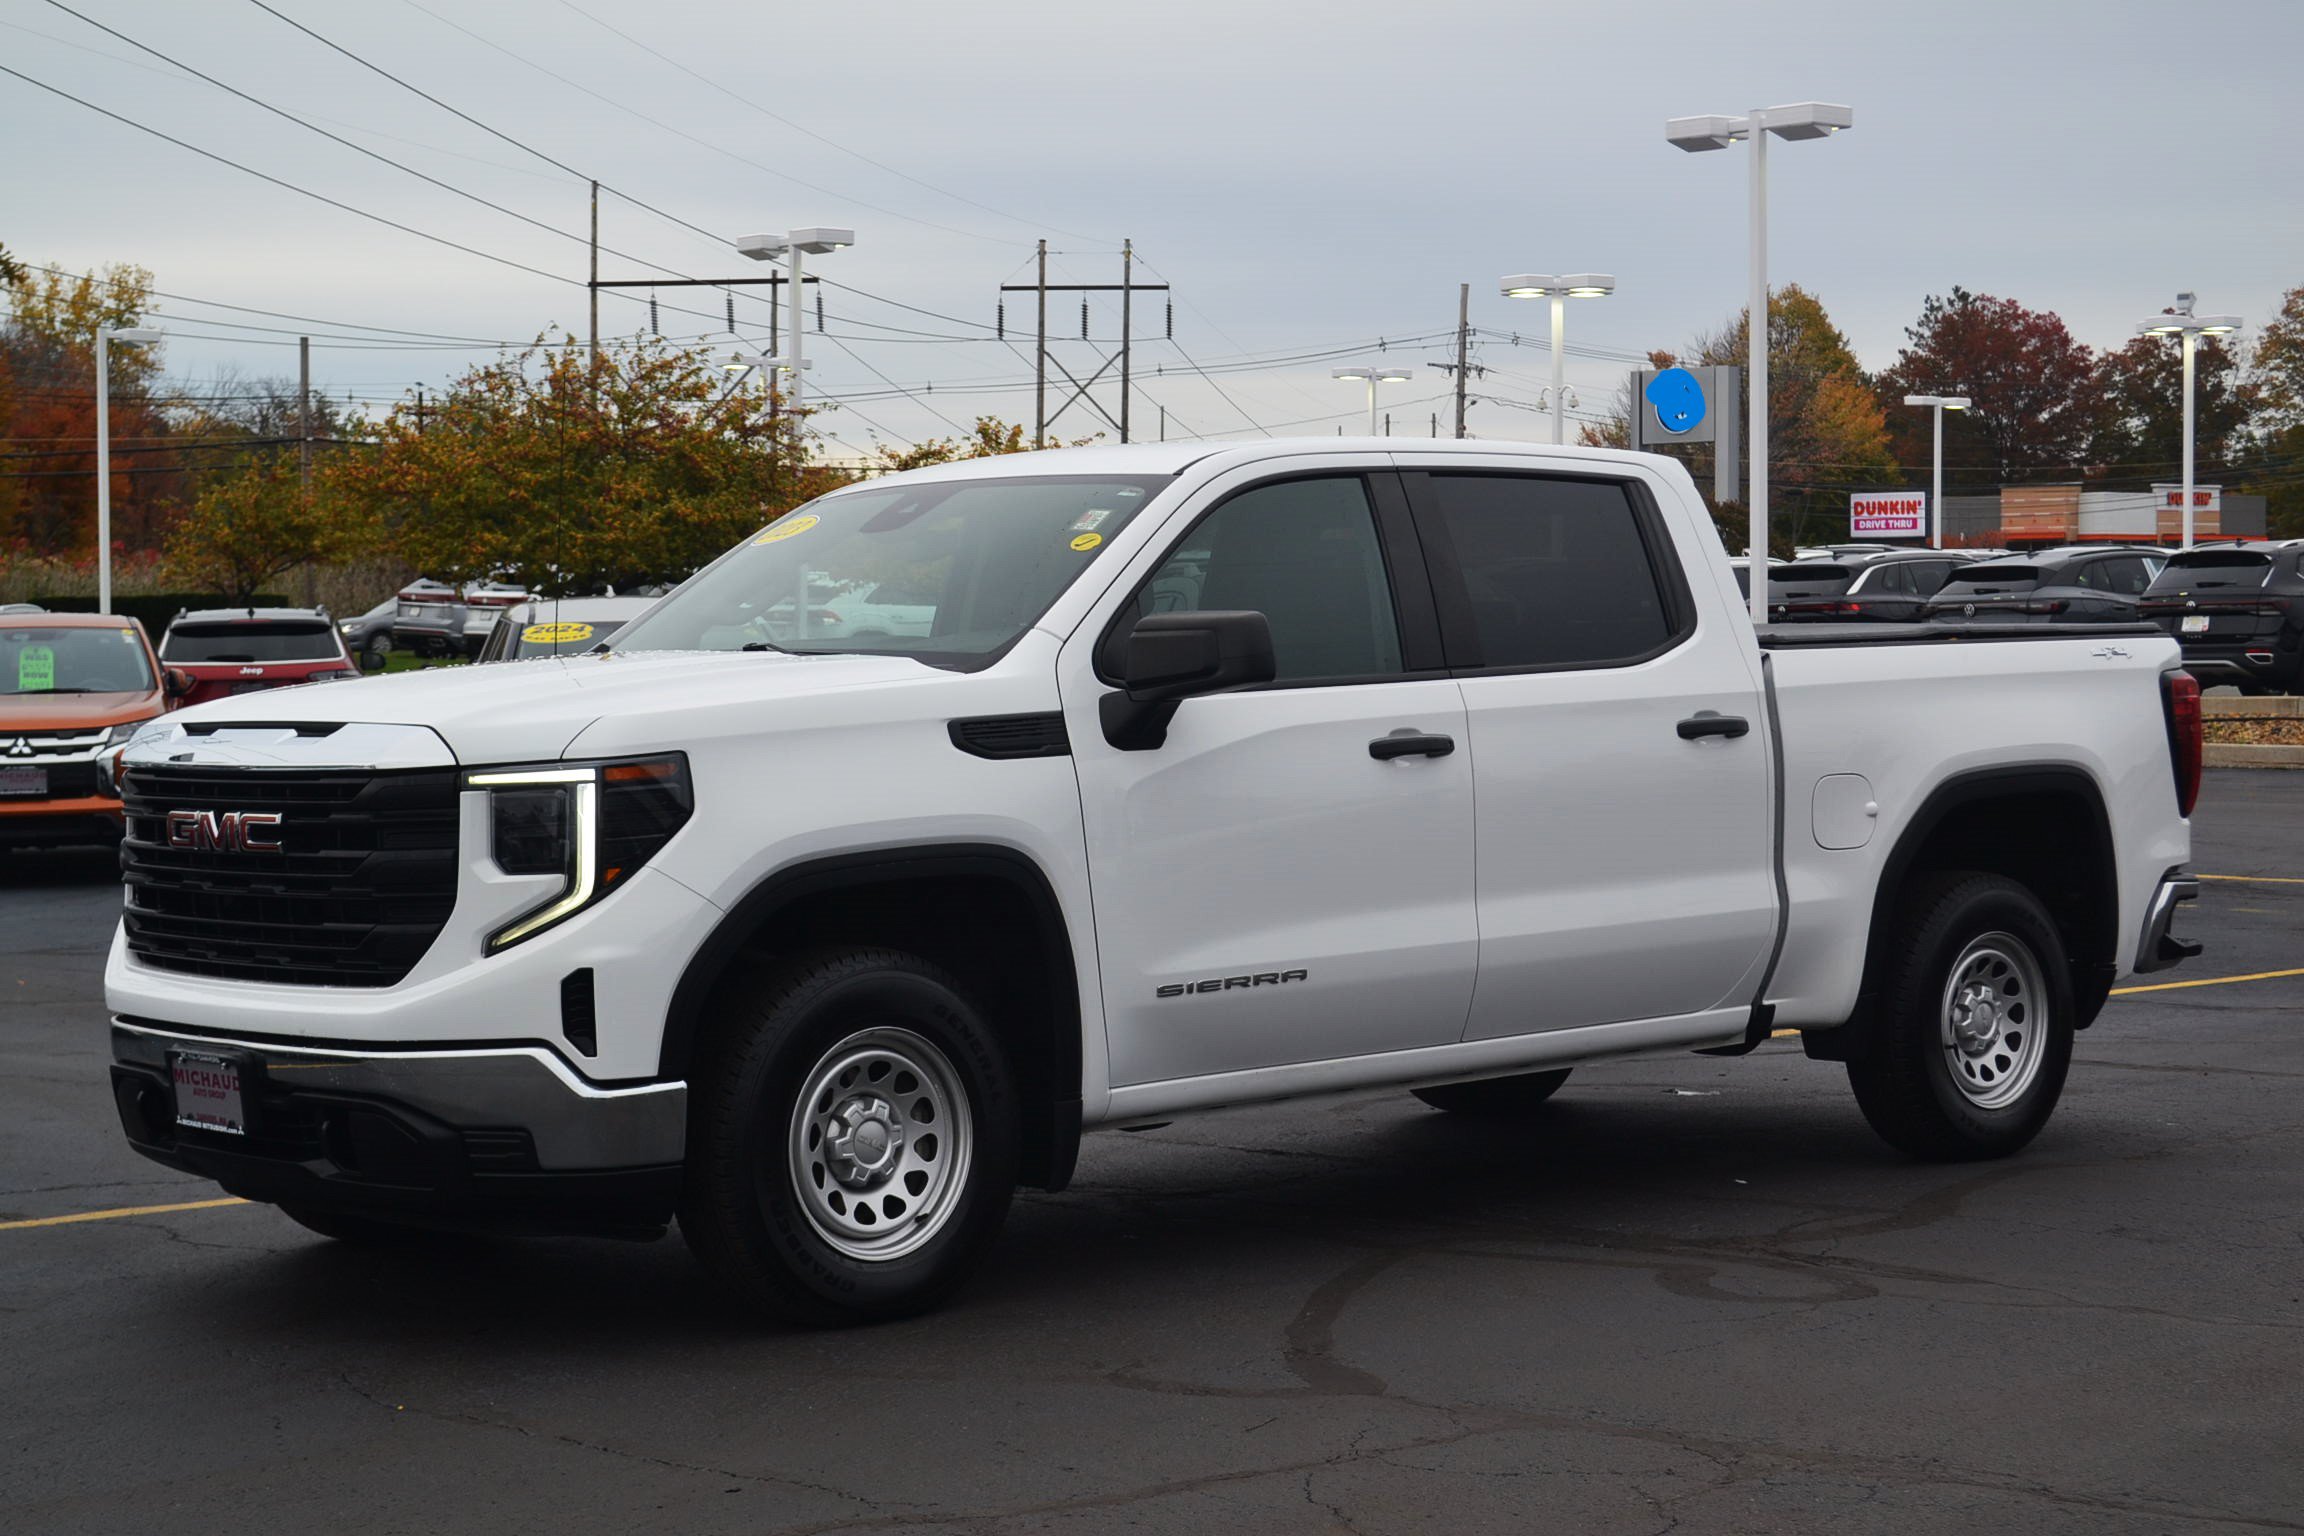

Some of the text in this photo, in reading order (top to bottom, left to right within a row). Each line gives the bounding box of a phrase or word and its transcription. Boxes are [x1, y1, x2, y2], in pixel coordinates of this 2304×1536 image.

[1853, 499, 1922, 517] DUNKIN'
[1860, 518, 1912, 529] DRIVE THRU
[239, 666, 264, 676] Jeep
[166, 810, 283, 852] GMC
[1156, 968, 1308, 998] SIERRA
[173, 1067, 241, 1091] MICHAUD
